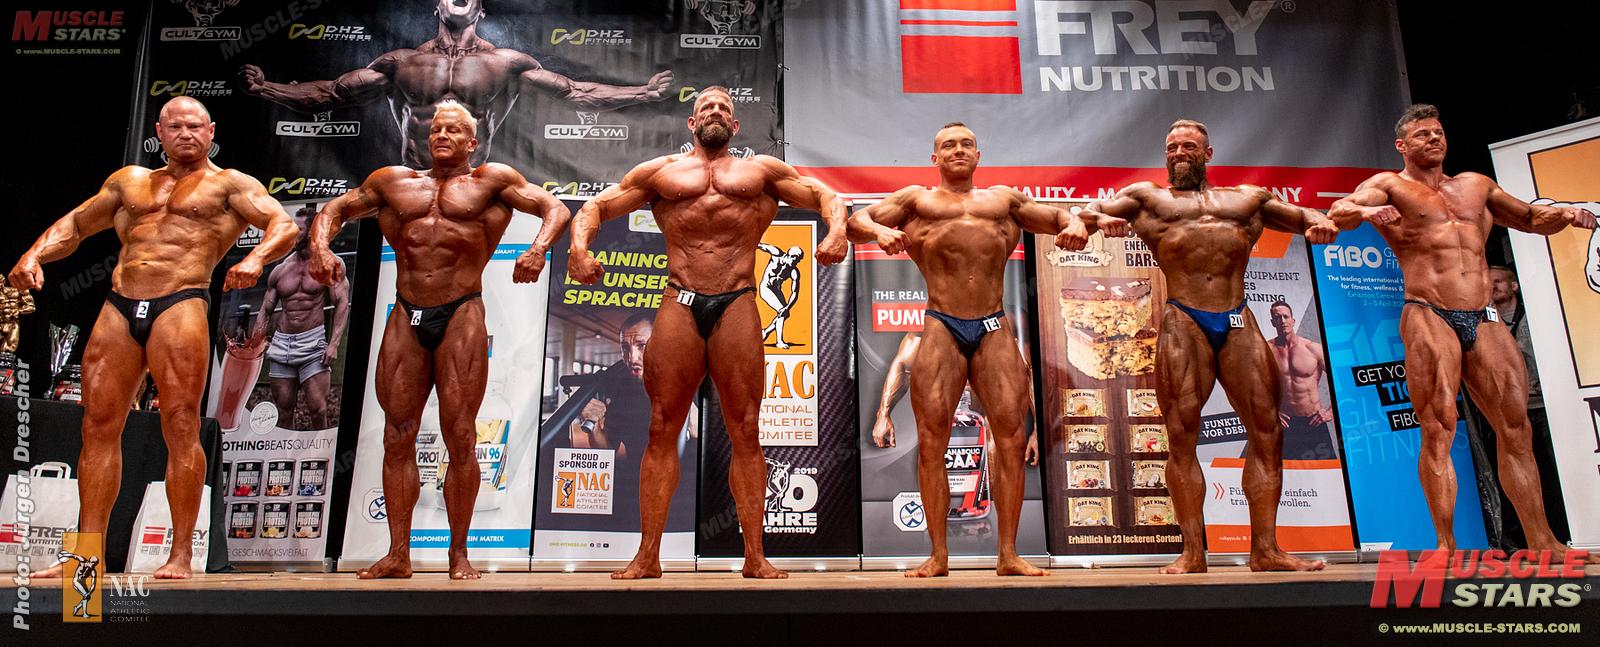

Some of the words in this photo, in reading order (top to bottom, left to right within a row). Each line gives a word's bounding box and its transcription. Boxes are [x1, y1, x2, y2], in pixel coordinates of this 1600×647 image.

[325, 26, 365, 35] DHZ
[1035, 0, 1278, 56] FREY
[166, 29, 203, 39] CULT
[204, 28, 238, 39] GYM
[322, 33, 372, 41] FITNESS
[586, 30, 624, 38] DHZ
[585, 37, 632, 45] FITNESS
[685, 37, 720, 45] CULT
[723, 37, 757, 46] GYM
[1040, 65, 1275, 92] NUTRITION
[187, 80, 226, 89] DHZ
[185, 88, 233, 96] FITNESS
[729, 87, 753, 95] HZ
[731, 95, 761, 103] NESS
[281, 123, 320, 135] CULT
[322, 123, 357, 134] GYM
[549, 126, 586, 137] CULT
[590, 126, 625, 137] GYM
[306, 178, 348, 188] DHZ
[1060, 255, 1076, 263] OAT
[1077, 255, 1100, 264] KING
[1324, 245, 1383, 268] FIBO
[1244, 271, 1300, 281] QUIPMENT
[1340, 275, 1361, 283] leading
[563, 290, 663, 309] SPRACHE
[874, 290, 895, 300] THE
[899, 290, 926, 300] REAL
[138, 305, 147, 316] 2
[985, 318, 999, 331] 14
[1230, 315, 1243, 327] 20
[1357, 368, 1382, 383] GET
[760, 405, 812, 414] ATIONAL
[759, 418, 813, 427] THLETIC
[759, 431, 813, 440] OMITEE
[1202, 428, 1223, 438] VOR
[489, 447, 500, 460] 96
[571, 453, 599, 461] PROUD
[559, 460, 597, 469] SPONSOR
[599, 461, 610, 469] OF
[794, 467, 818, 475] 2019
[577, 472, 611, 491] NAC
[1284, 489, 1318, 497] einfach
[764, 526, 817, 535] Germany
[1068, 535, 1103, 544] Erhältlich
[1112, 535, 1122, 543] 23
[1123, 534, 1155, 543] leckeren
[1156, 534, 1182, 543] Sorten!
